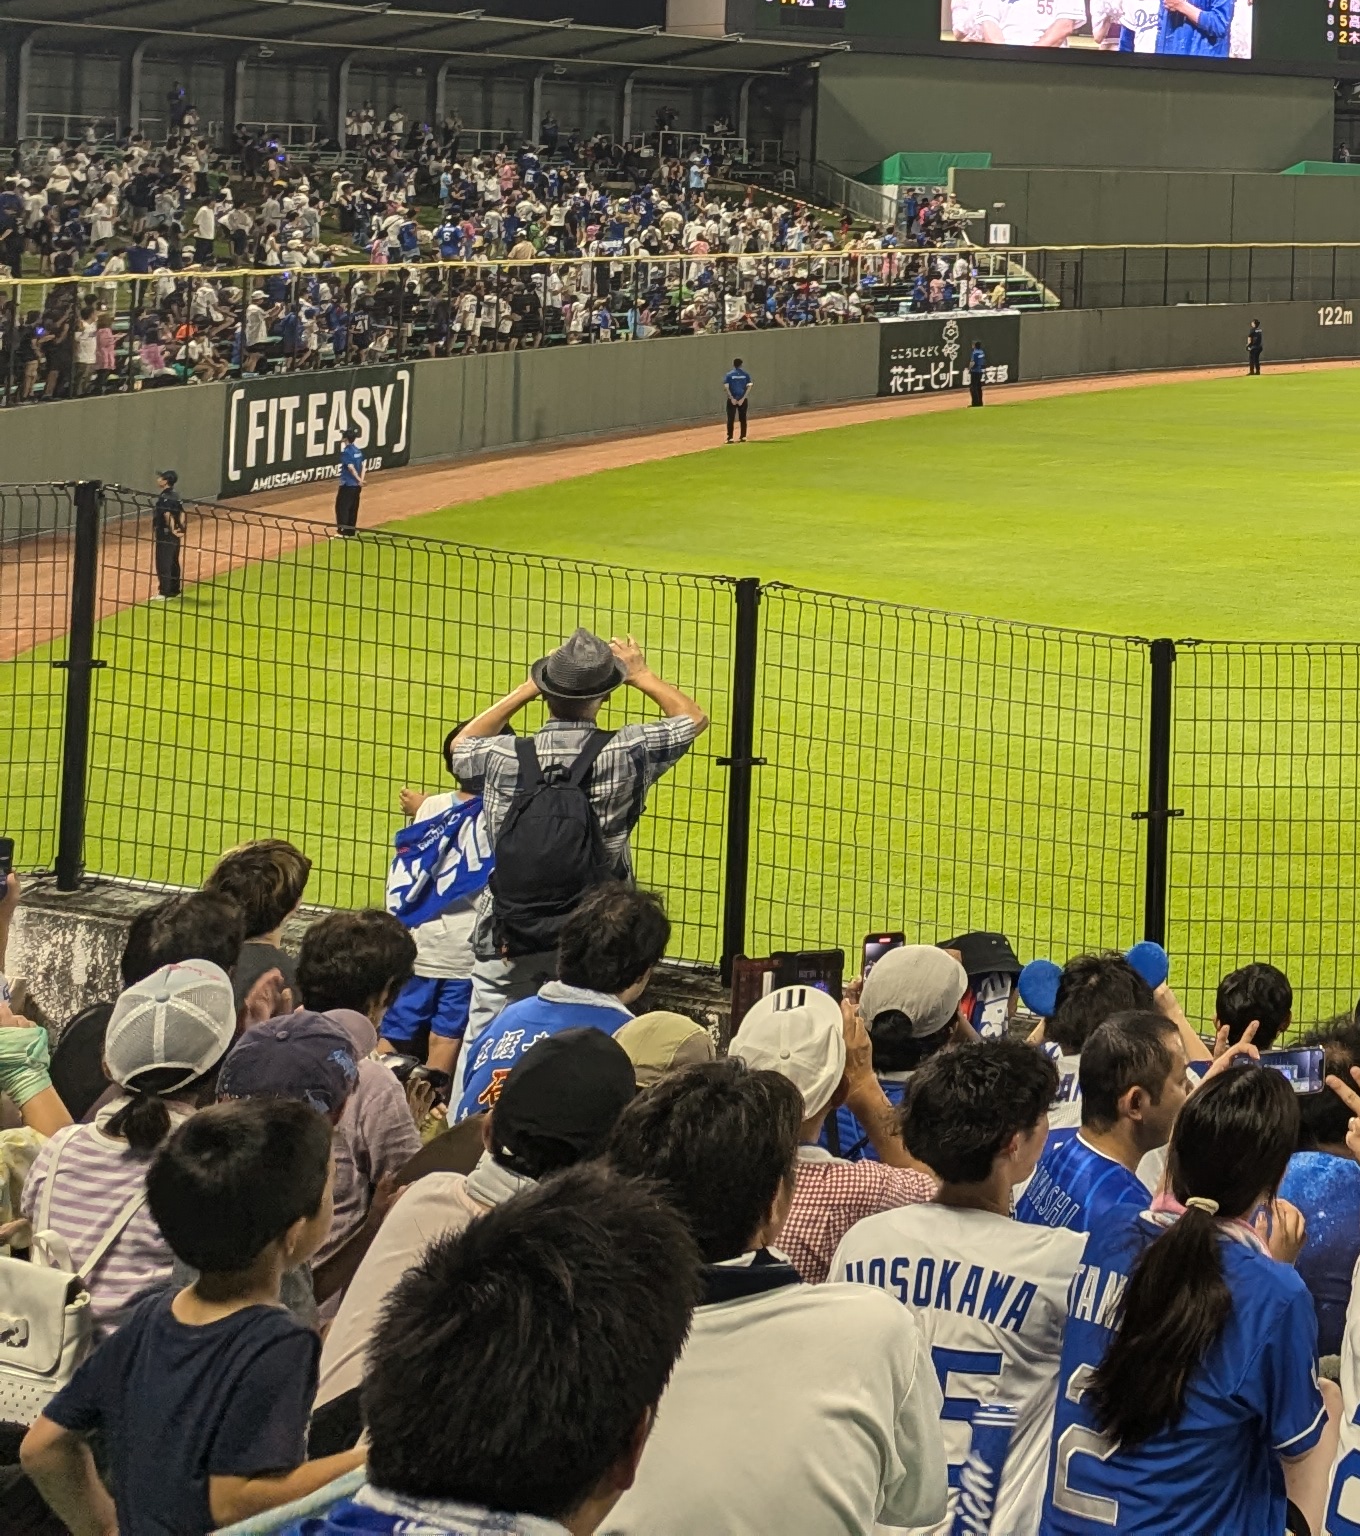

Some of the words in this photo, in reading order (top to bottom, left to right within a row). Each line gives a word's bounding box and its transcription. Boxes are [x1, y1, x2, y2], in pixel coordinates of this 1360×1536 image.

[1327, 14, 1335, 26] 8
[1339, 15, 1348, 27] 5
[1326, 30, 1335, 42] 9
[1338, 30, 1348, 44] 2
[1317, 306, 1353, 326] 122m
[890, 345, 940, 360] こころにとどく
[890, 360, 960, 394] 花キューピット
[251, 468, 315, 493] AMUSEMENT
